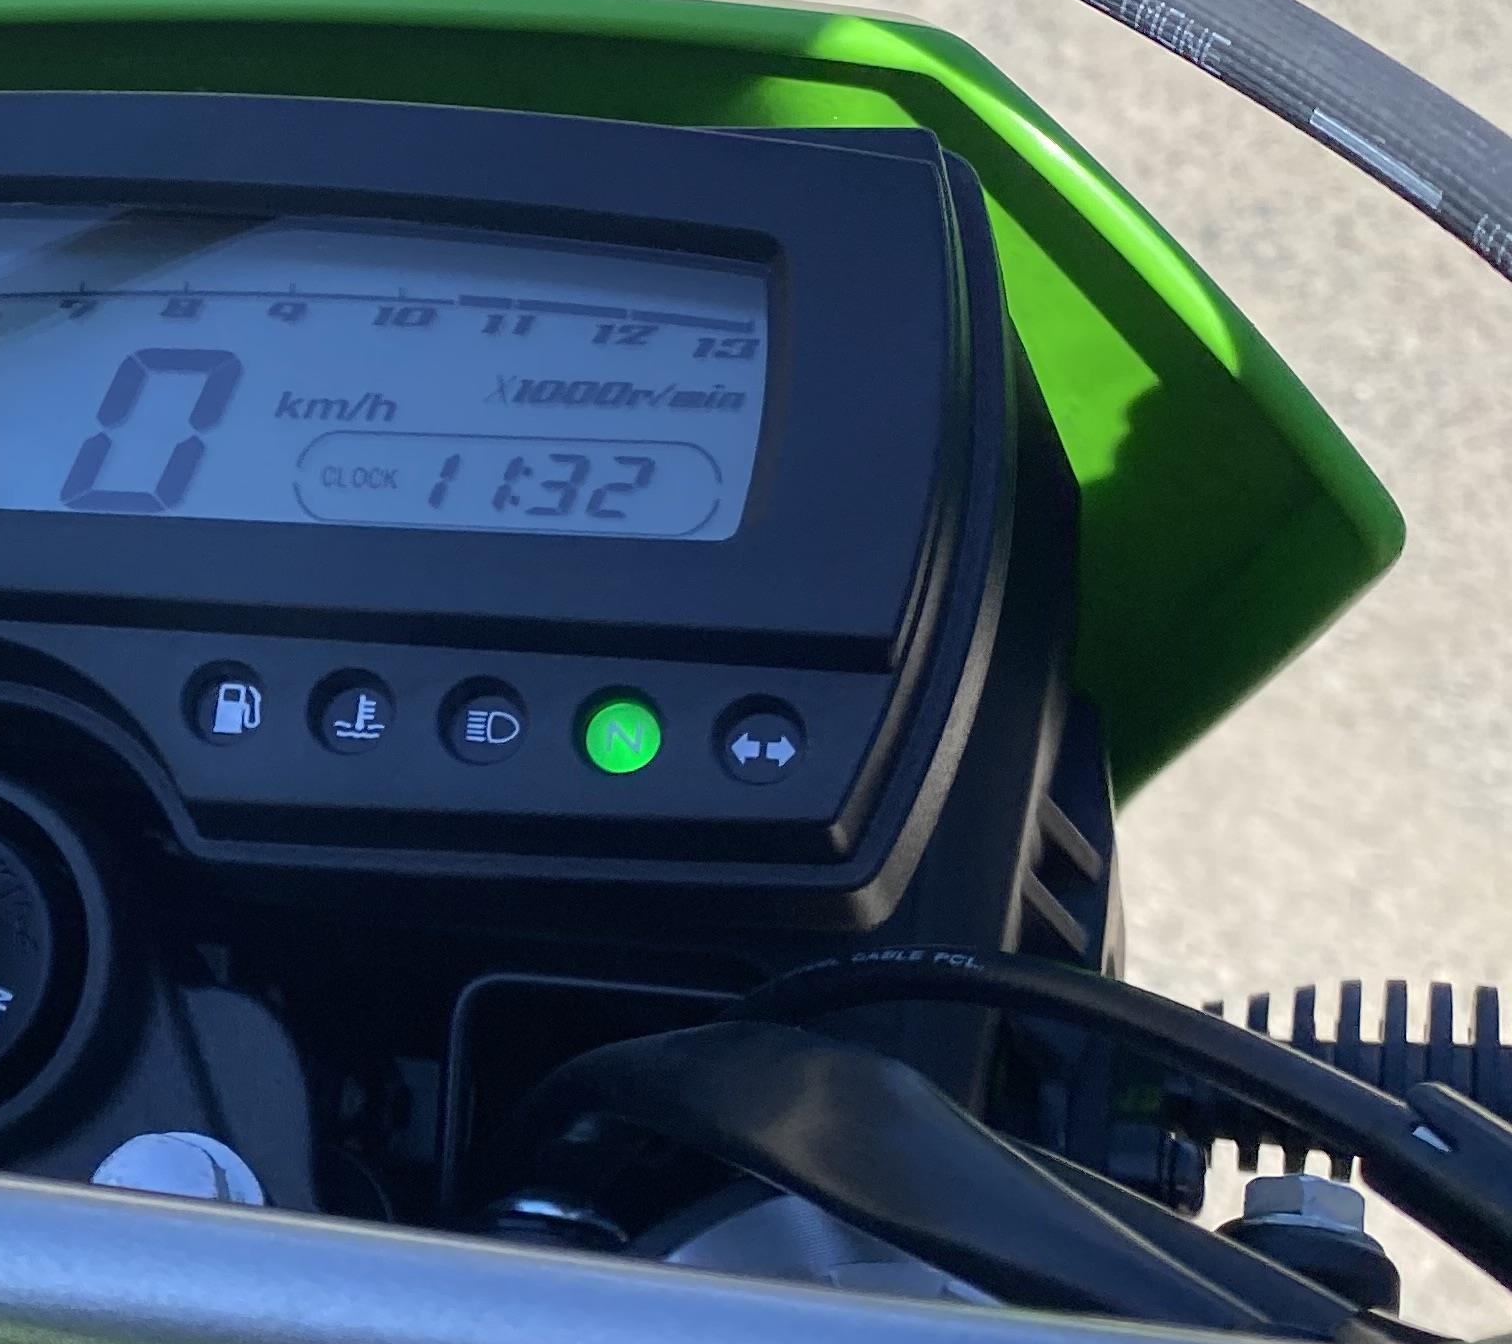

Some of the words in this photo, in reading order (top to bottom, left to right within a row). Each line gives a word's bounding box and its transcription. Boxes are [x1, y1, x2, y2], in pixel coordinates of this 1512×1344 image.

[267, 301, 307, 322] 9
[370, 305, 437, 328] 10
[481, 313, 536, 336] 11
[592, 323, 659, 345] 12
[692, 336, 760, 359] 13
[59, 348, 243, 512] 0
[274, 390, 398, 422] km/h
[321, 464, 399, 490] CLOCK
[428, 453, 656, 519] 11:32
[605, 718, 645, 756] N
